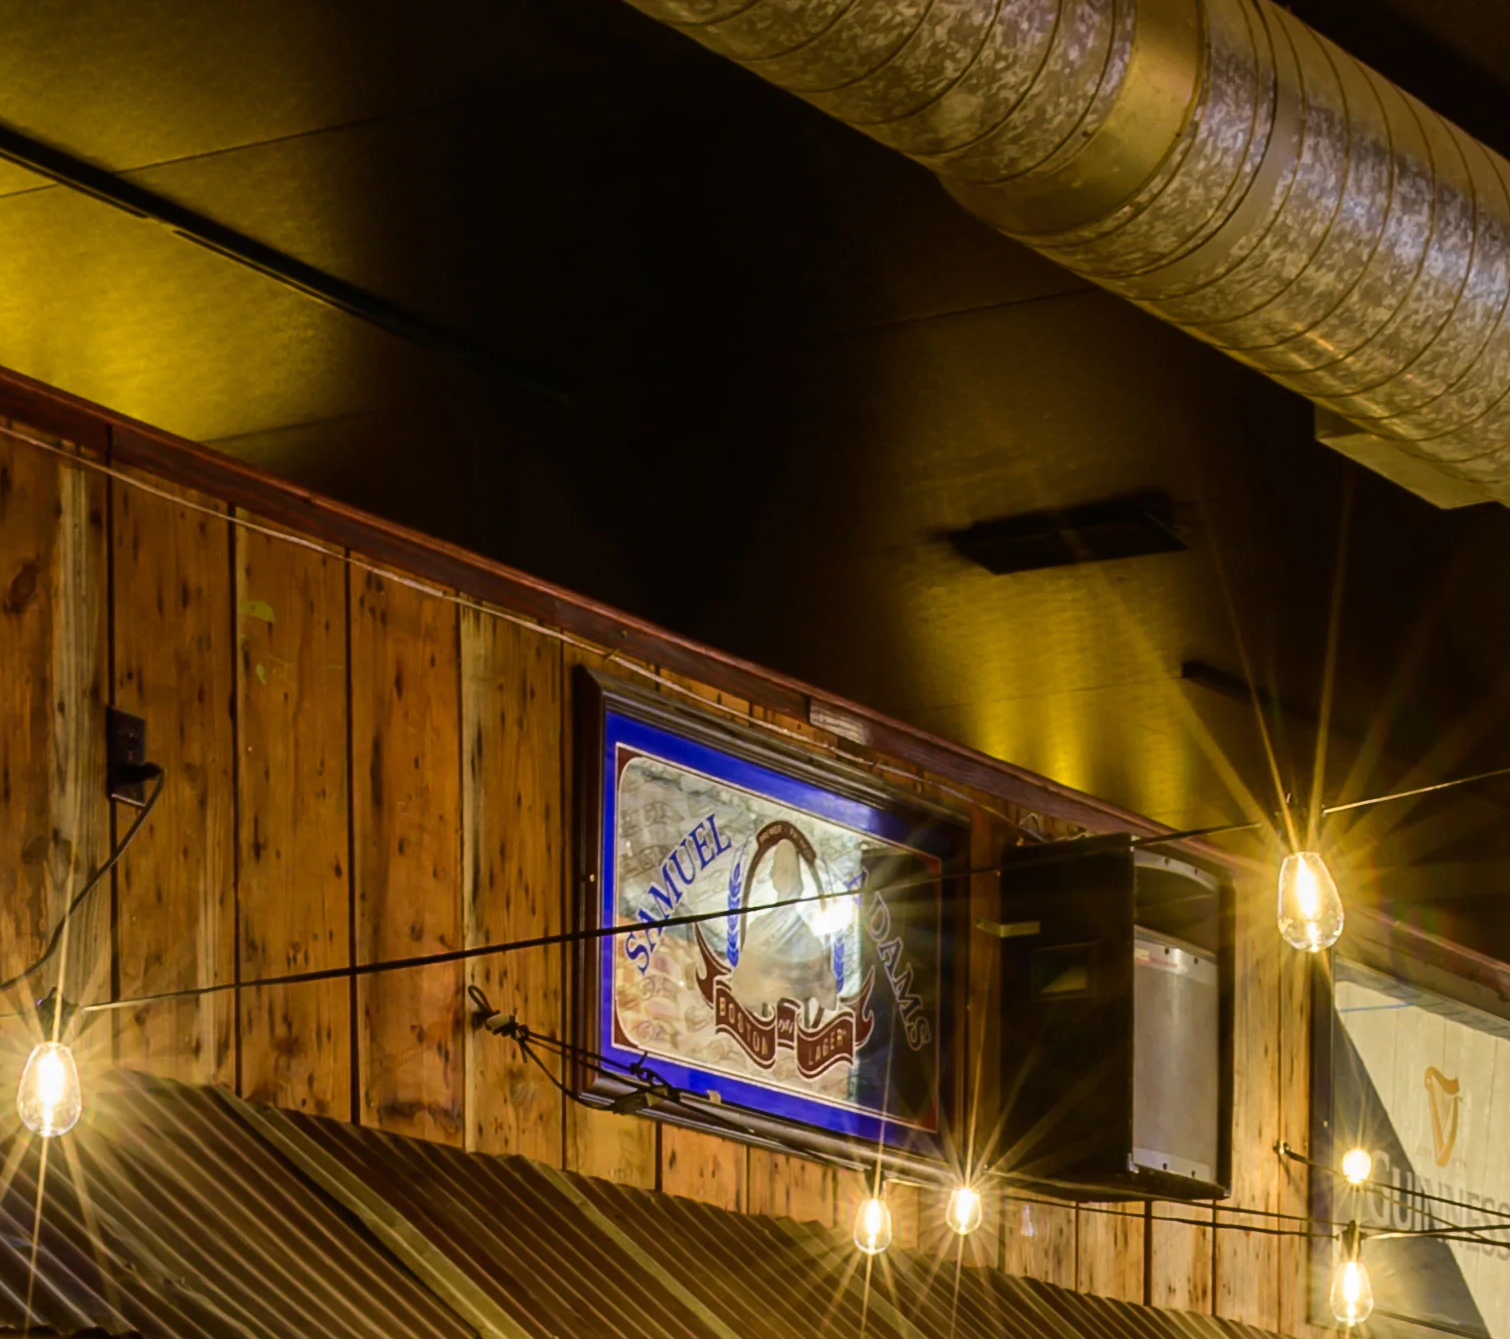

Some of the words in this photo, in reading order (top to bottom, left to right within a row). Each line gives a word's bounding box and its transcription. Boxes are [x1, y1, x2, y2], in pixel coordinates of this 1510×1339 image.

[625, 812, 733, 977] SAMUEL
[718, 996, 770, 1056] BOSTON
[807, 1030, 842, 1066] LAGER
